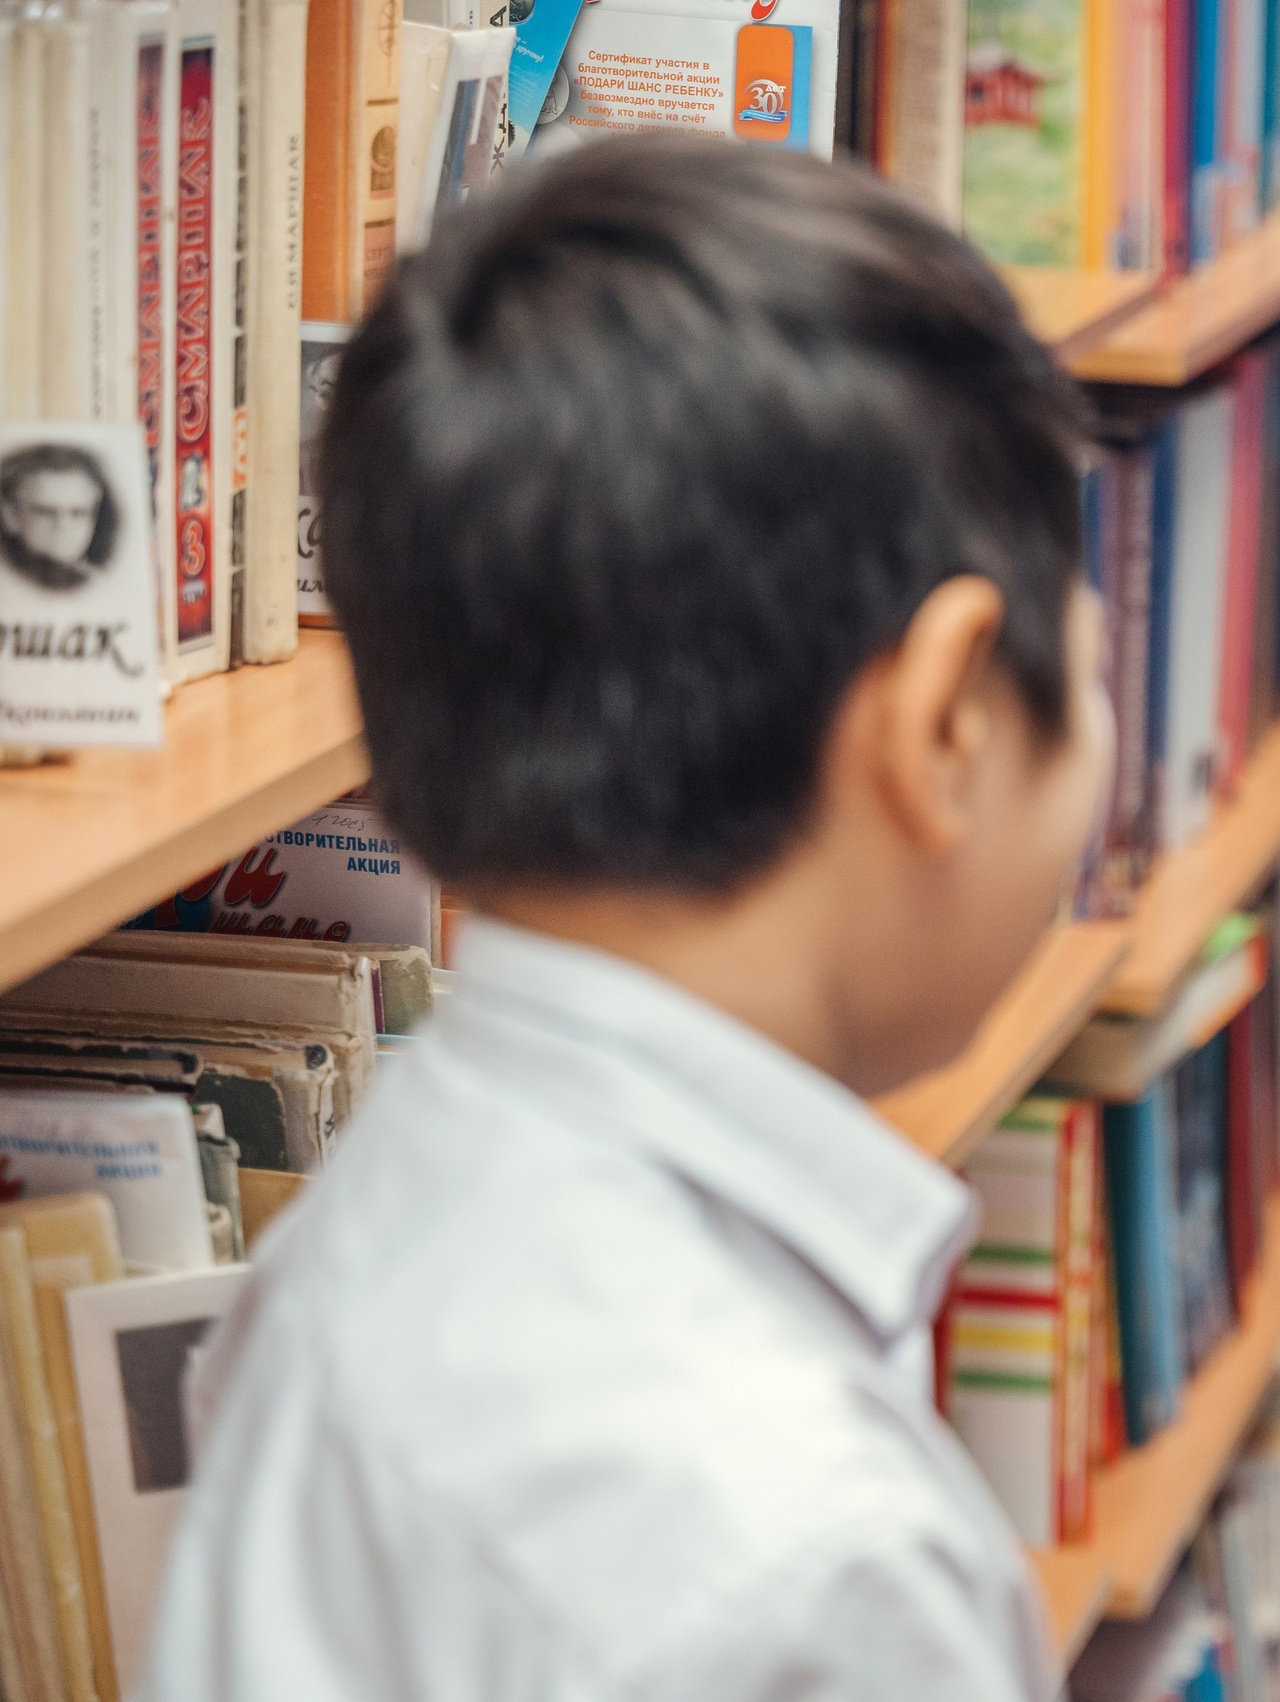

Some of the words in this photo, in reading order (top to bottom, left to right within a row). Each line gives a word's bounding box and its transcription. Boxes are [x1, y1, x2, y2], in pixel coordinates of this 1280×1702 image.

[588, 50, 653, 66] Сертификат
[655, 58, 700, 70] участия
[703, 62, 710, 70] в
[578, 63, 684, 82] благотворительной
[686, 74, 720, 85] акции
[573, 76, 625, 90] «ПОДАРИ
[628, 80, 662, 93] ШАНС
[665, 84, 725, 98] РЕБЕНКУ»
[580, 90, 655, 106] безвозмездно
[658, 98, 716, 112] вручается
[749, 86, 778, 114] 30
[569, 115, 635, 131] Российского
[588, 104, 614, 118] тому,
[617, 108, 634, 118] кто
[637, 110, 663, 120] внёс
[665, 113, 679, 122] на
[681, 114, 707, 124] счёт
[0, 621, 146, 679] шак
[346, 857, 401, 875] АКЦИЯ
